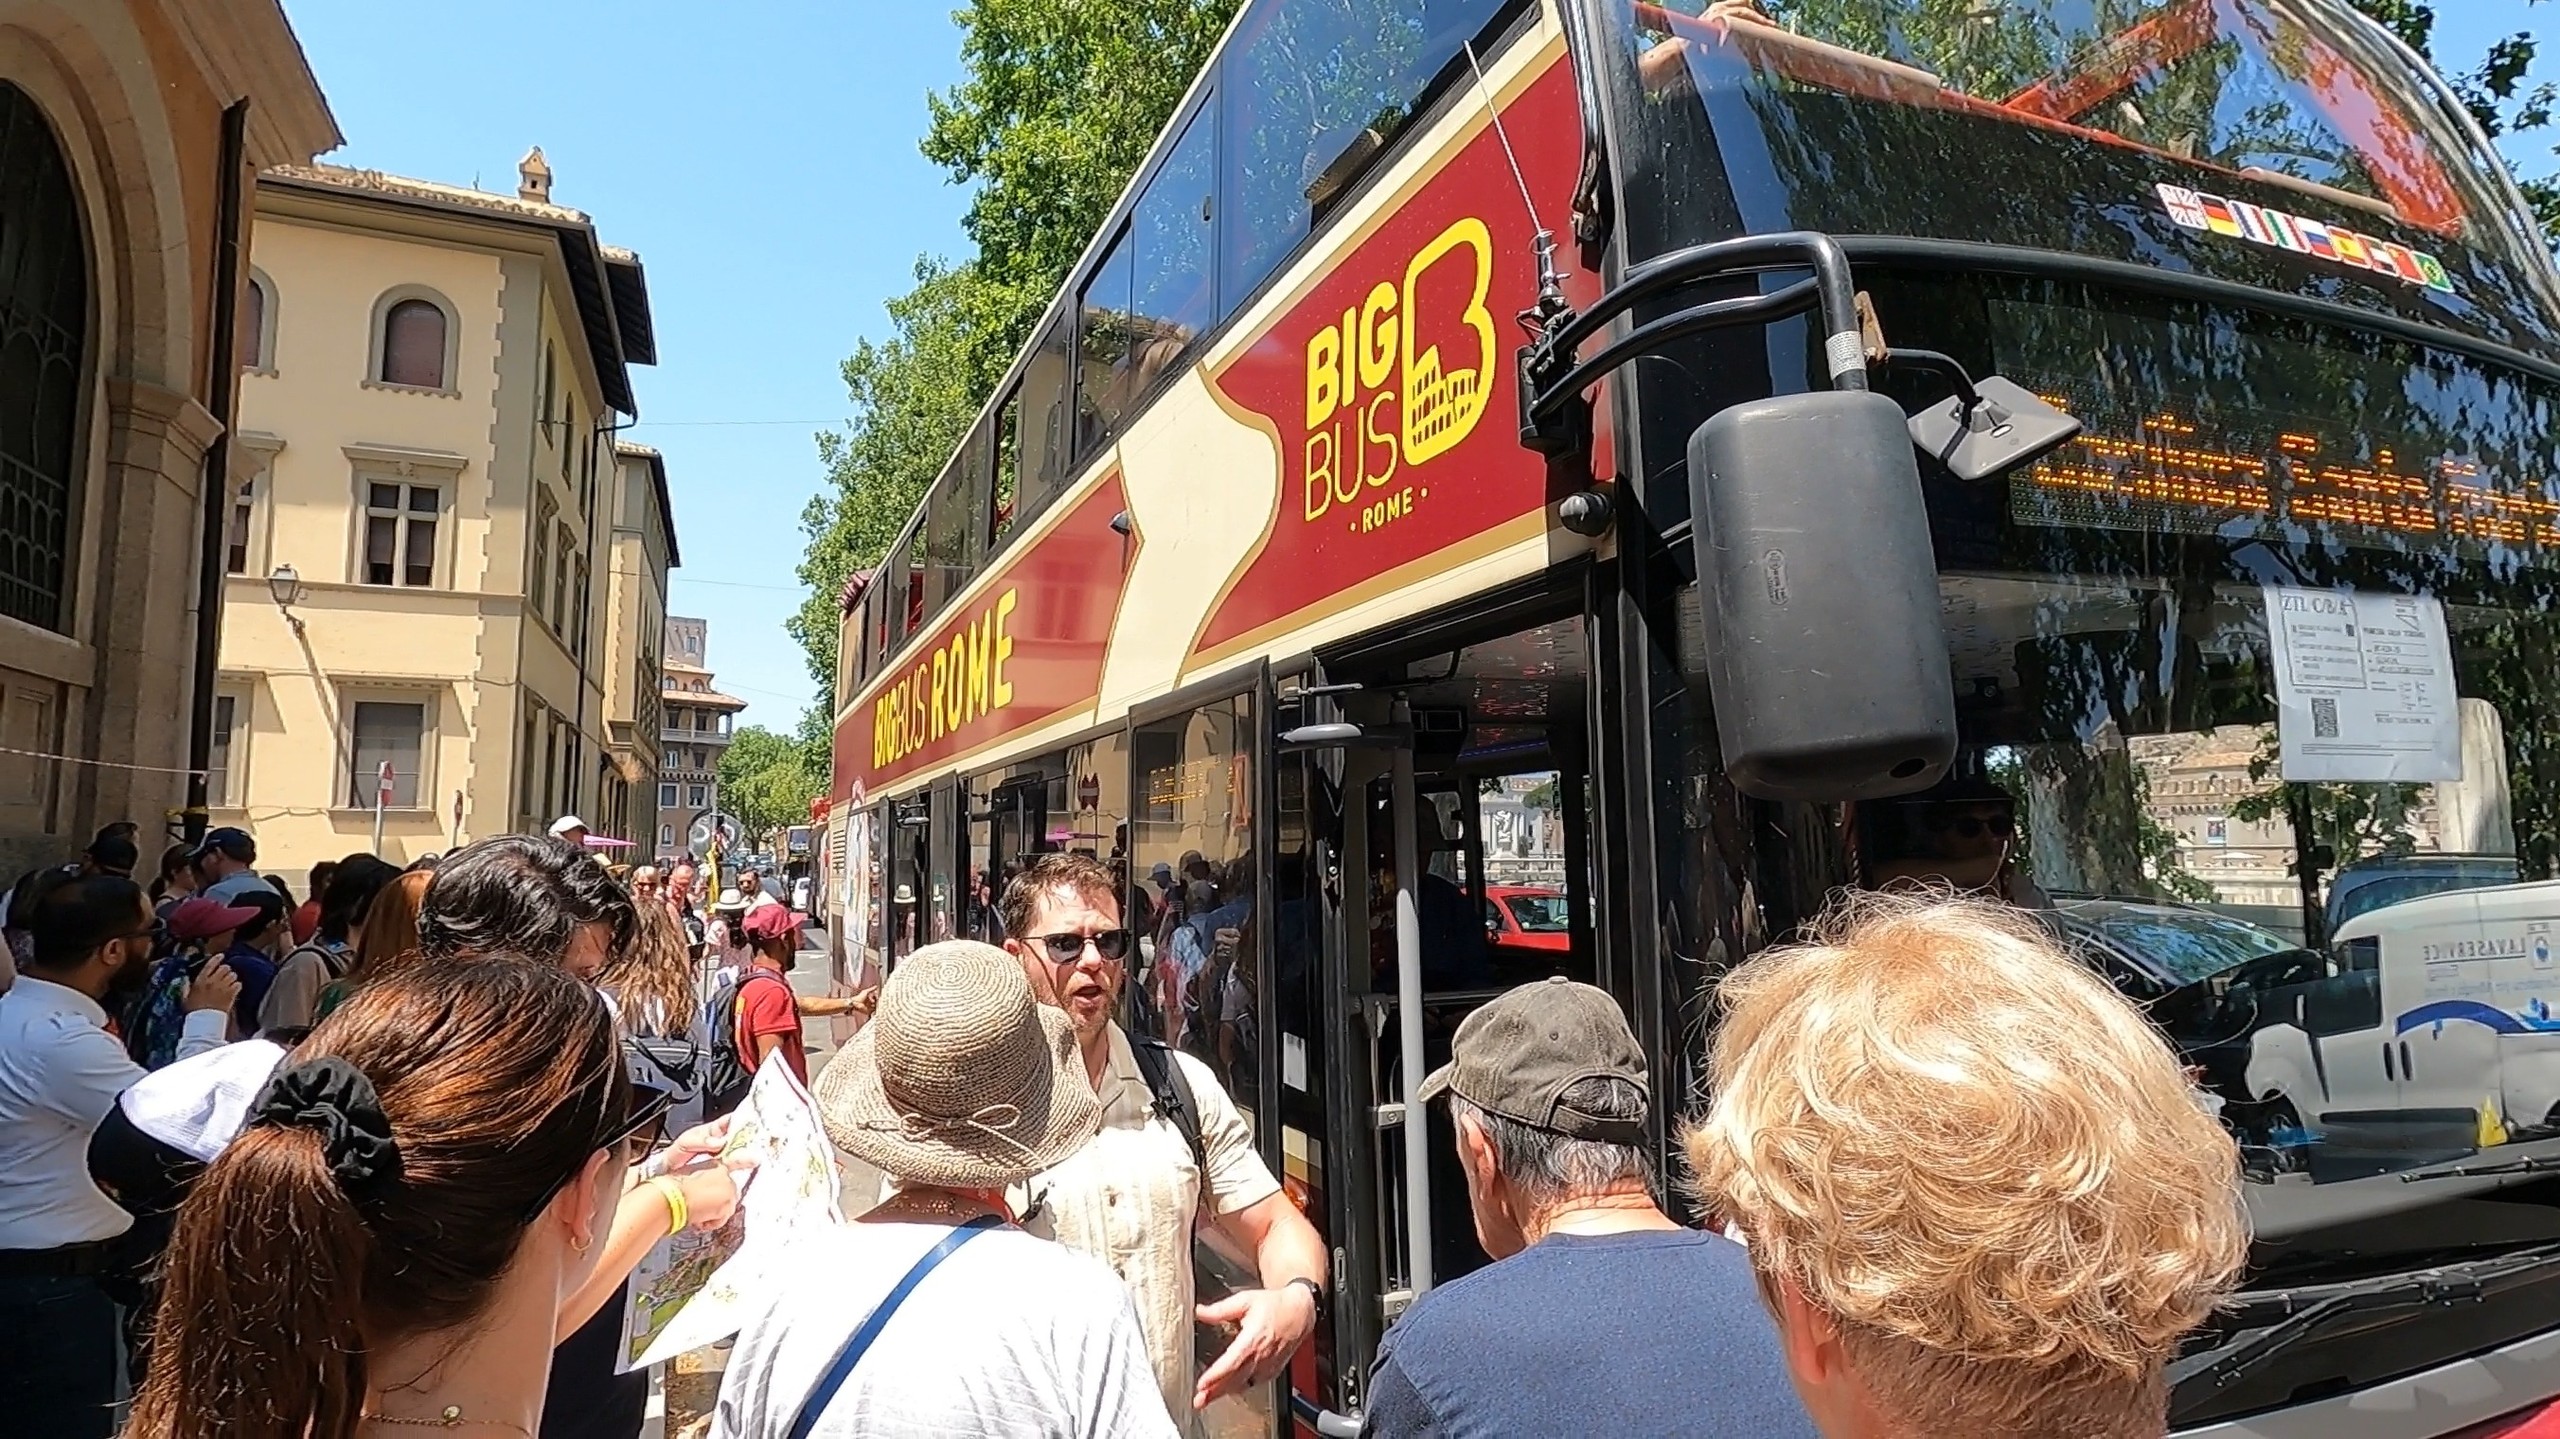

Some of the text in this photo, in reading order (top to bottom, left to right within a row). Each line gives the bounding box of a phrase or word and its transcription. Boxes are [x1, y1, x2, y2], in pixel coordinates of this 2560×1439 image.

[1306, 281, 1398, 431] BIG
[1304, 390, 1398, 522] BUS
[1362, 486, 1413, 533] ROME
[930, 587, 1018, 743] ROME
